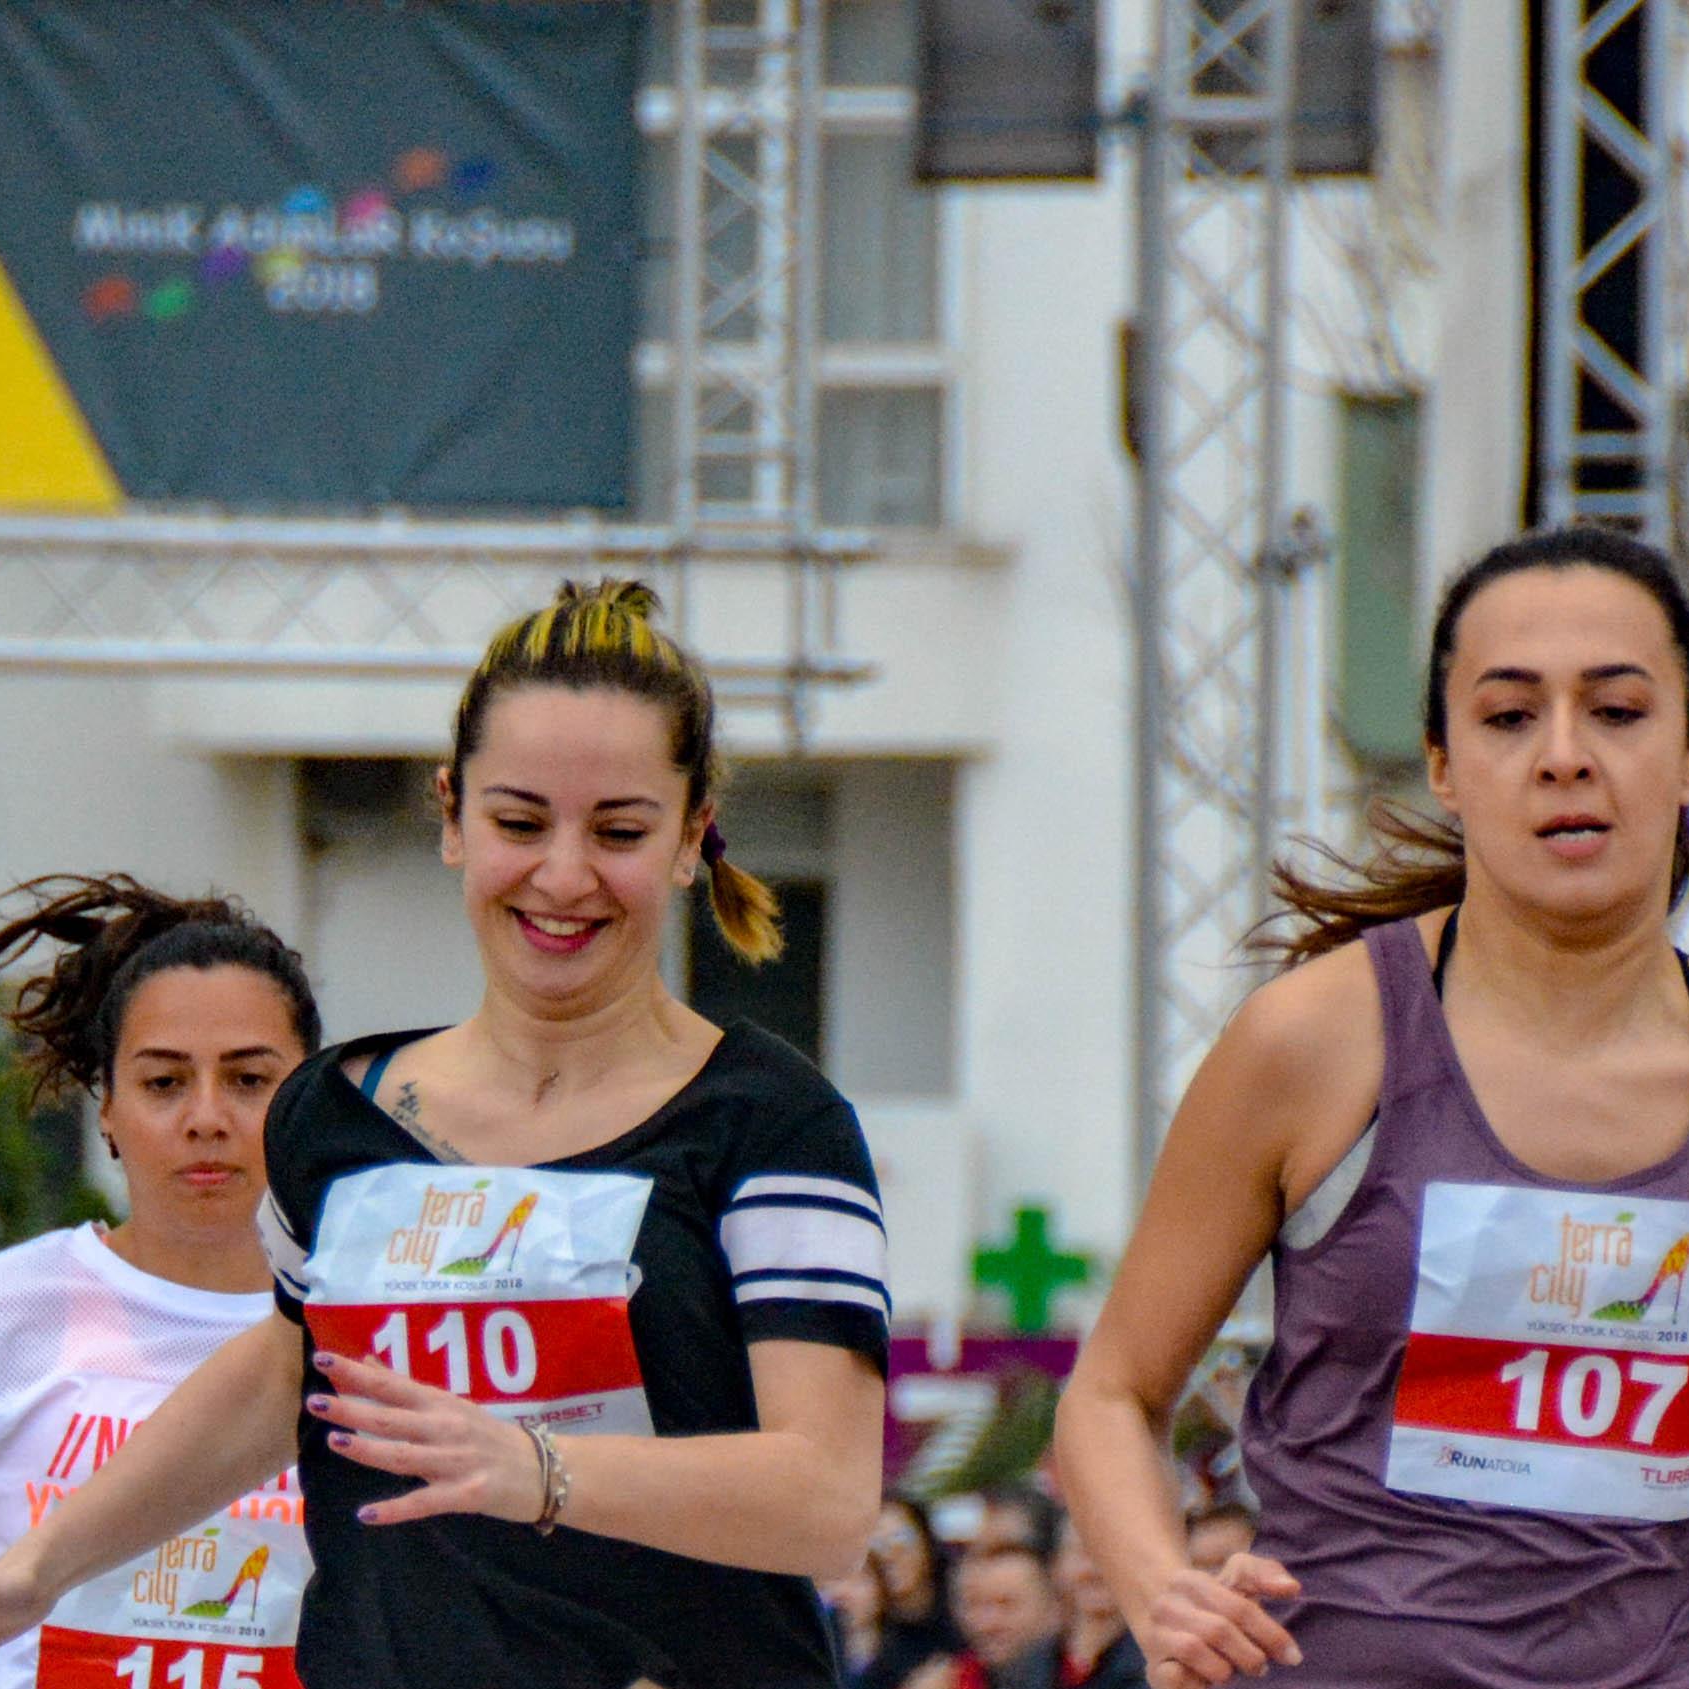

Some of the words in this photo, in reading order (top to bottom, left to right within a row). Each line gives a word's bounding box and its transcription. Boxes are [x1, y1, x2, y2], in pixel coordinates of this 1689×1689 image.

[420, 1182, 487, 1229] terra
[386, 1226, 440, 1276] city
[1561, 1212, 1633, 1268] terra
[494, 1277, 524, 1289] 2018
[1529, 1262, 1586, 1319] city
[373, 1310, 537, 1396] 110
[1657, 1330, 1688, 1343] 2018
[1500, 1349, 1689, 1446] 107
[133, 1567, 178, 1616] city
